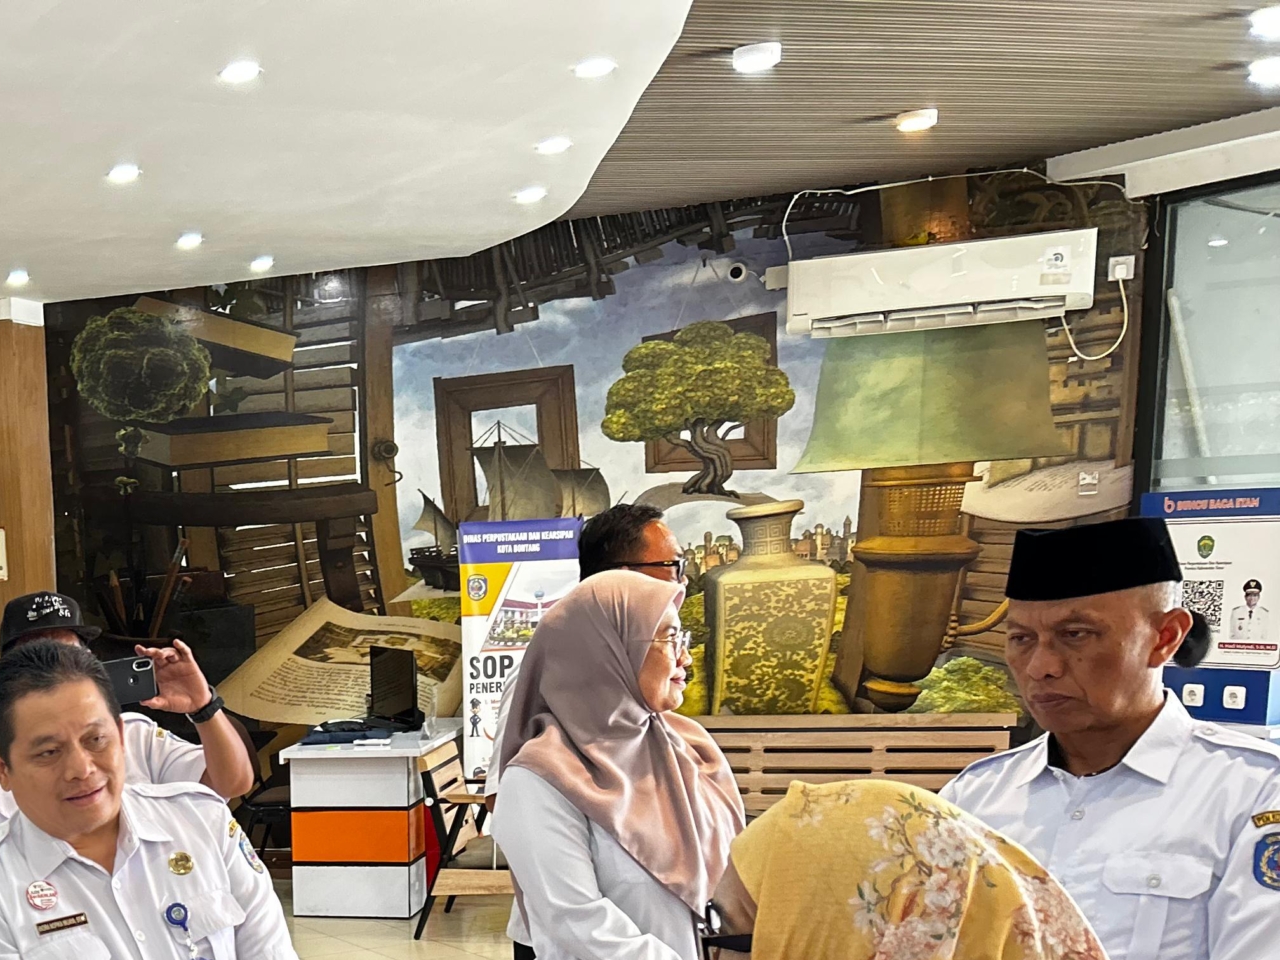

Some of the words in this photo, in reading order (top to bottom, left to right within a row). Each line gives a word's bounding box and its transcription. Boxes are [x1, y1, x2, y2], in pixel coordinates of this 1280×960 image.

[463, 534, 481, 544] DINAS
[482, 532, 528, 542] PERPUSTAKAAN
[528, 531, 540, 541] DAN
[541, 530, 574, 540] KEARSIPAN
[497, 544, 513, 554] KOTA
[513, 543, 540, 553] BONTANG
[469, 654, 514, 680] SOP
